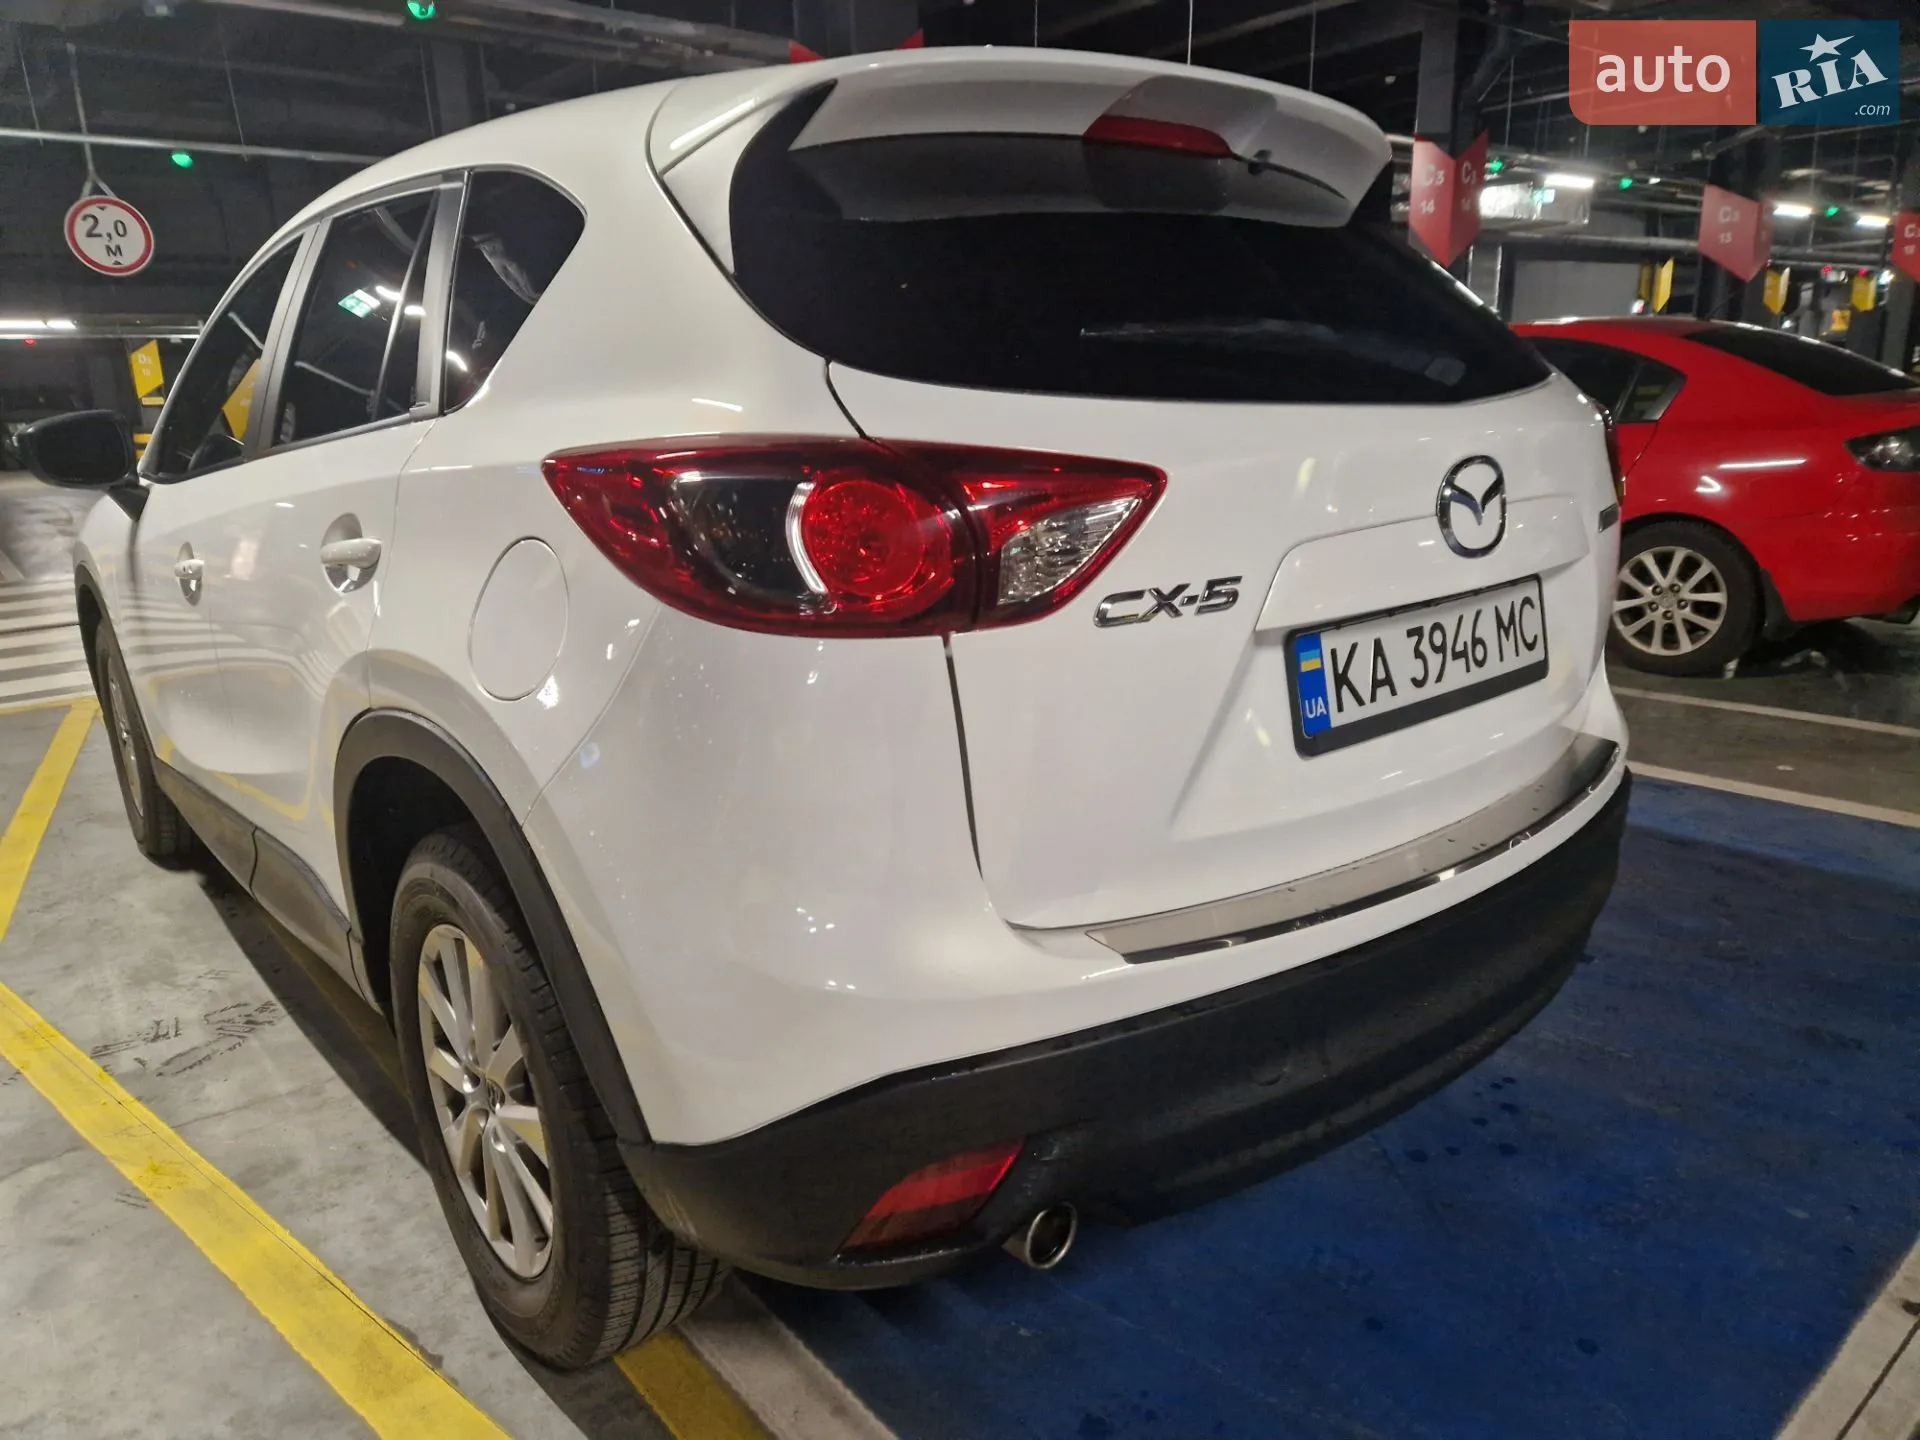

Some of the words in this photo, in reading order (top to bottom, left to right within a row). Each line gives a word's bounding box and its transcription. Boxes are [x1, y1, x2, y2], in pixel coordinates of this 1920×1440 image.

[82, 213, 128, 242] 2,0
[1093, 575, 1243, 628] CX-5
[1330, 637, 1398, 713] KA
[1406, 608, 1488, 689] 3946
[1494, 595, 1539, 663] MC
[1305, 696, 1328, 719] UA
